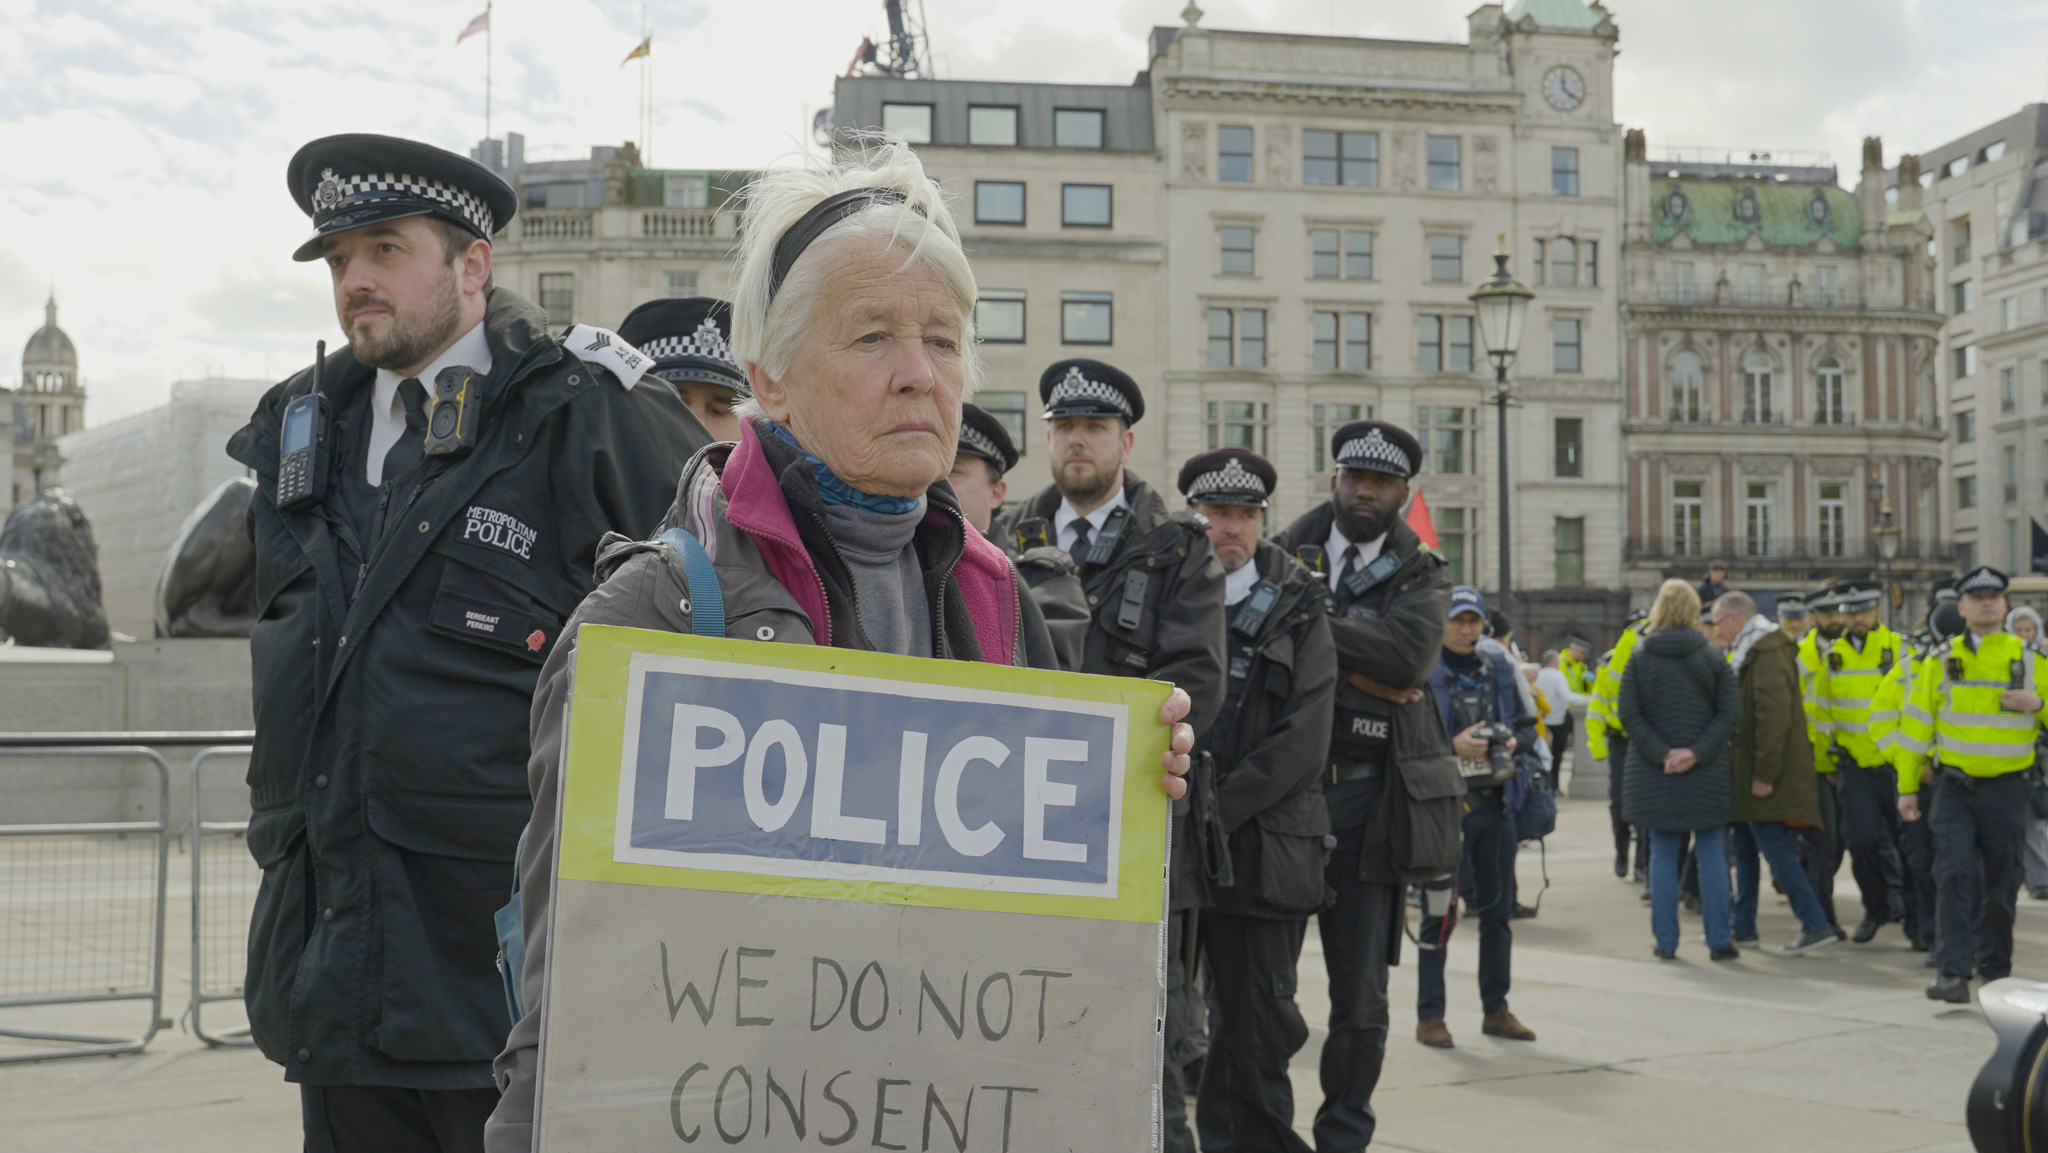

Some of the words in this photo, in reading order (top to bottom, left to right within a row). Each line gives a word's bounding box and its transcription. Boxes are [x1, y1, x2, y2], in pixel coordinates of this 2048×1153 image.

[615, 346, 630, 360] AS
[463, 519, 533, 560] POLICE
[466, 506, 538, 543] METROPOLITAN
[465, 611, 500, 625] SERGEANT
[466, 620, 495, 632] PERKINS
[1352, 717, 1389, 739] POLICE
[664, 702, 1089, 863] POLICE
[660, 941, 776, 1028] WE
[810, 957, 890, 1033] DO
[917, 968, 1073, 1044] NOT
[669, 1062, 1040, 1153] CONSENT
